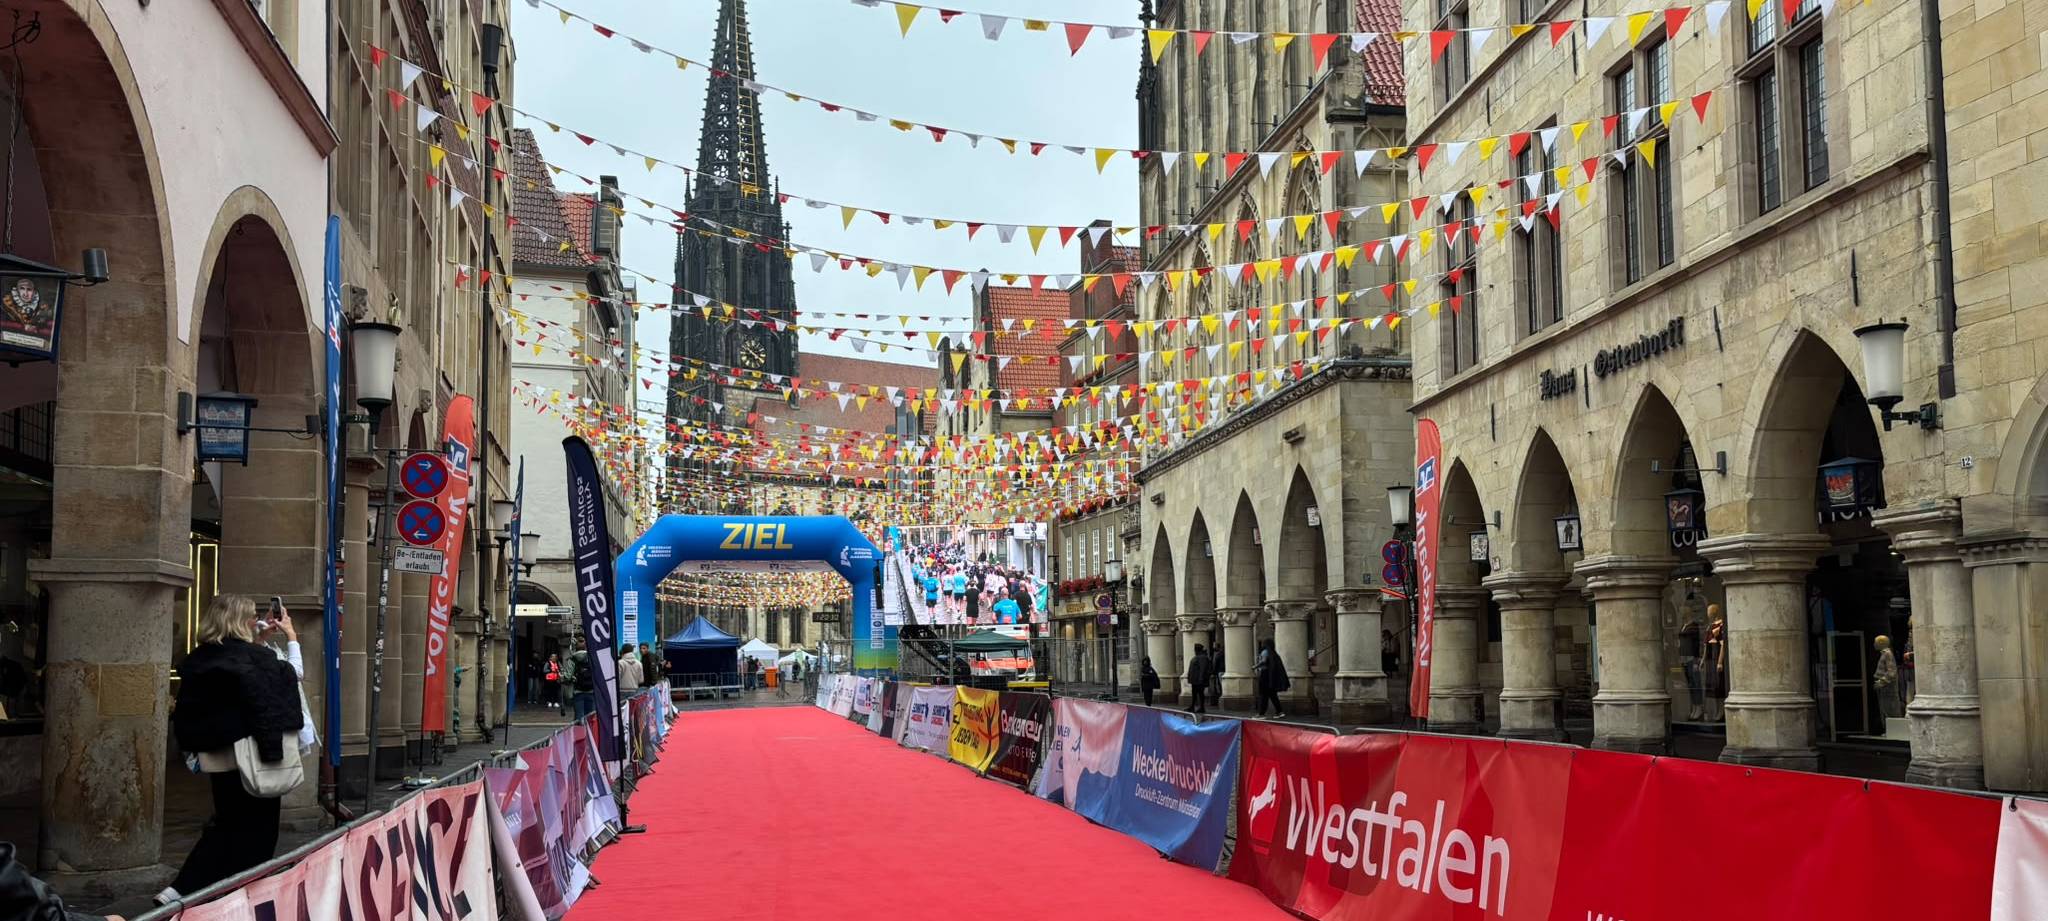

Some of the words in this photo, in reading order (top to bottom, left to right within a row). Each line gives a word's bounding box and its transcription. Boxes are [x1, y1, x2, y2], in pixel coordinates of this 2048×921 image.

[1540, 367, 1577, 401] Haus
[1594, 316, 1685, 379] Ostendorff
[1961, 457, 1971, 467] 12
[720, 523, 794, 550] ZIEL
[405, 561, 430, 570] erlaubt
[1286, 774, 1510, 917] Westfalen
